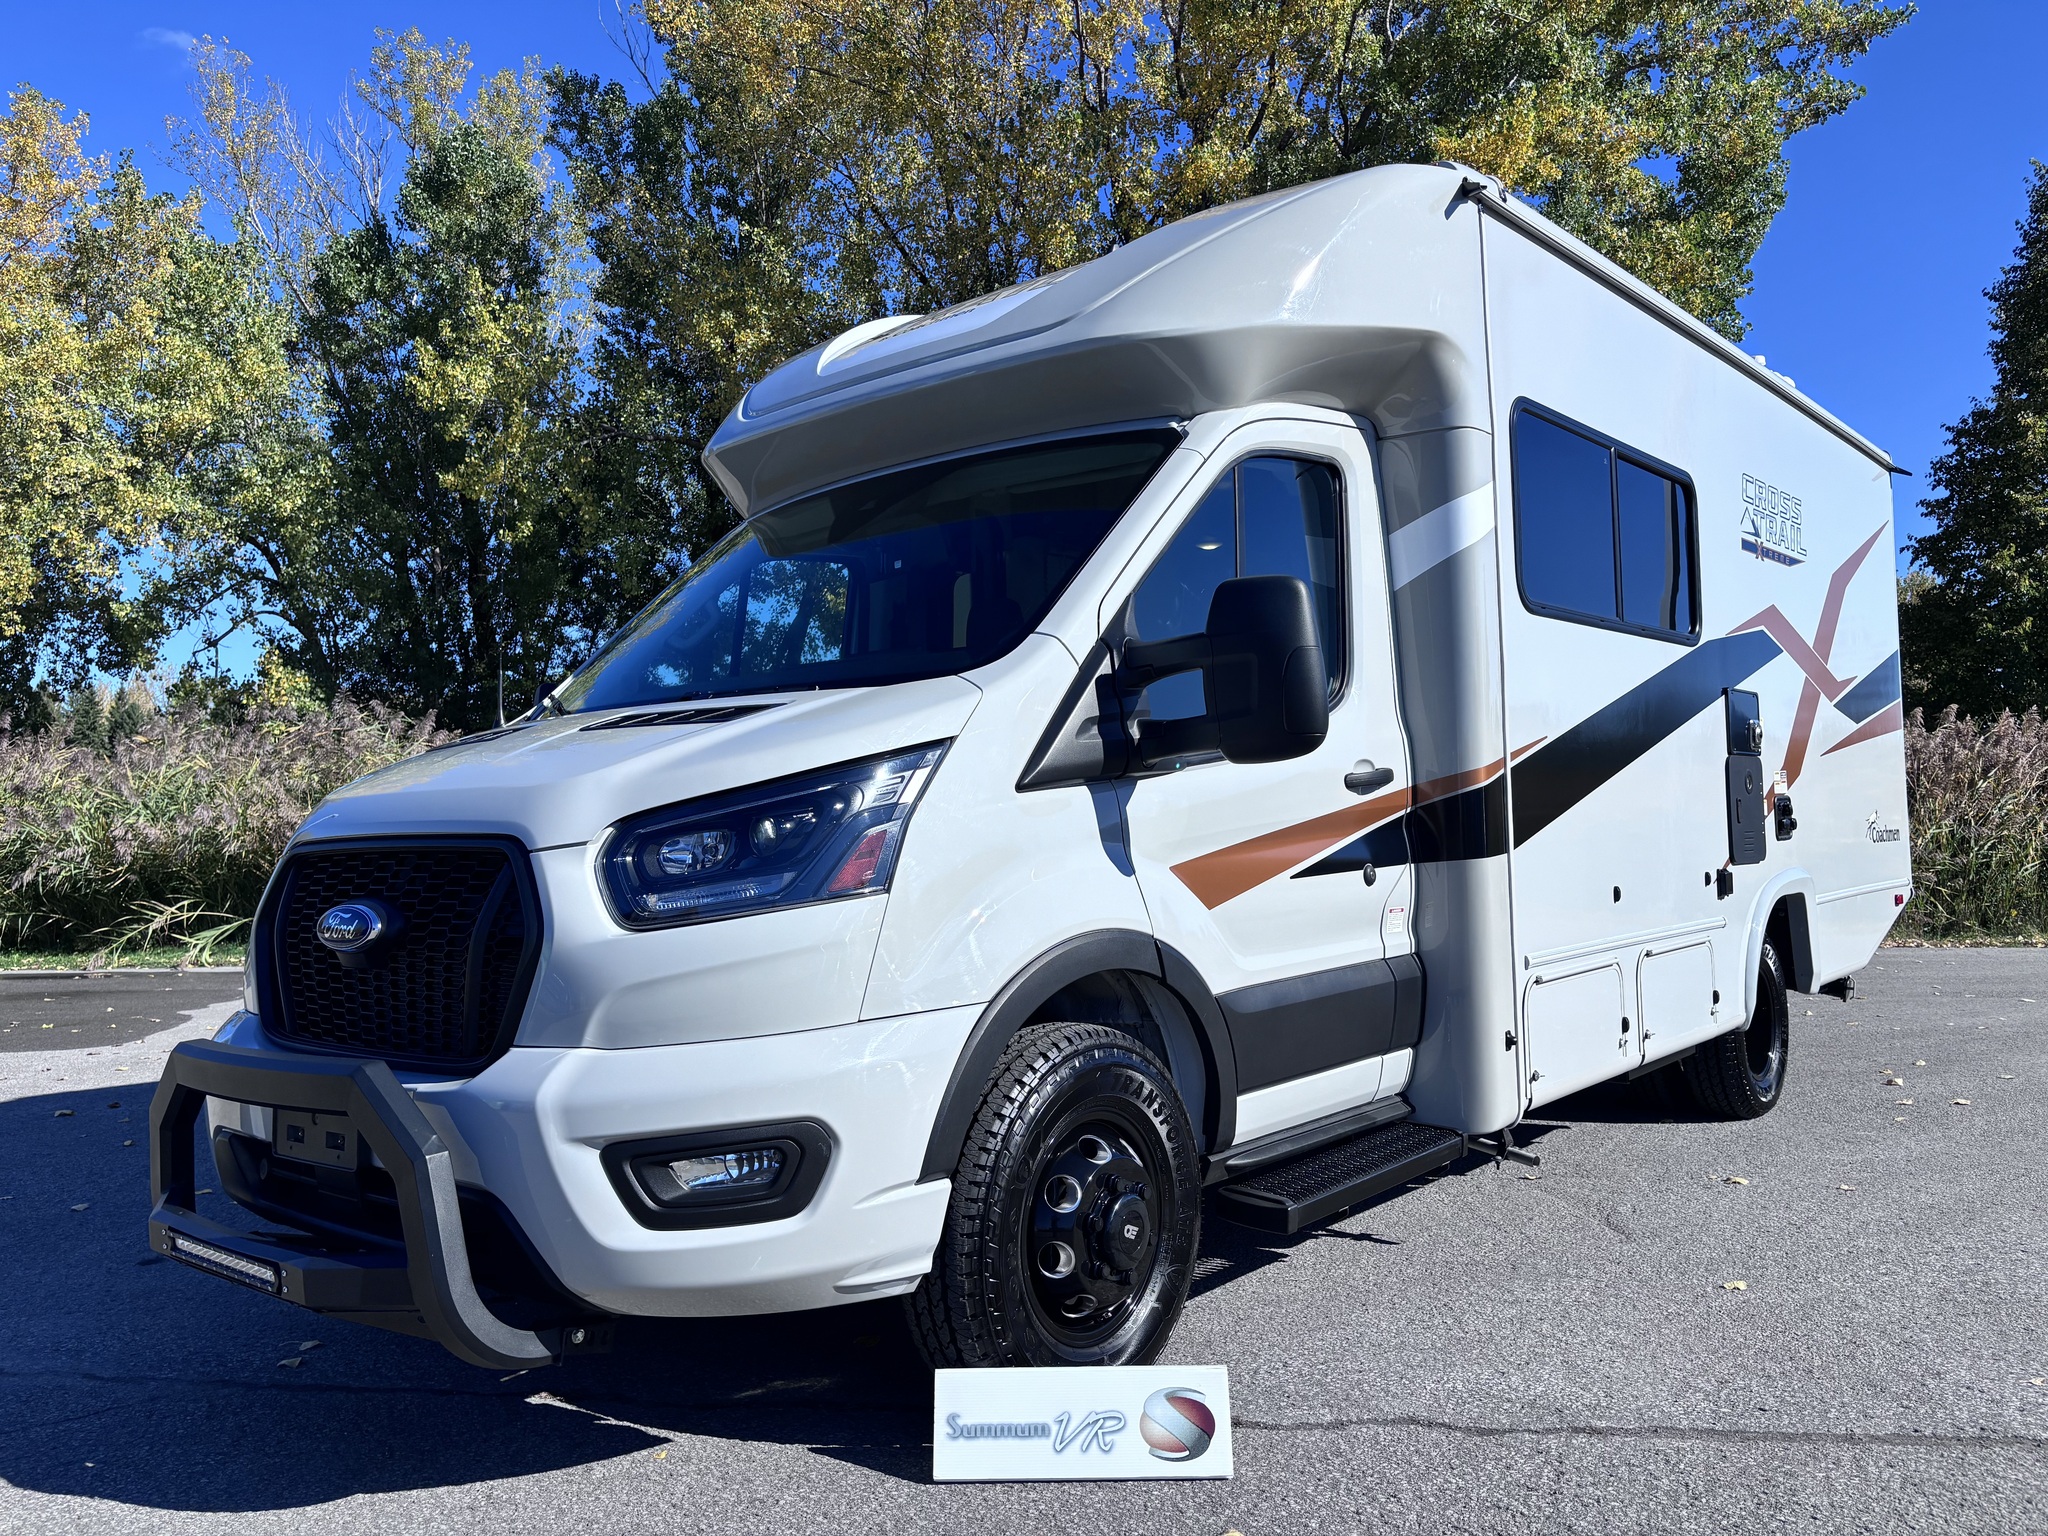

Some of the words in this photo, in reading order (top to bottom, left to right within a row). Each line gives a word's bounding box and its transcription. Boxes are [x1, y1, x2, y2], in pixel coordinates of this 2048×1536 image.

[1741, 472, 1802, 526] CROSS
[1752, 508, 1807, 557] TRAIL
[321, 911, 359, 939] Ford
[1111, 1072, 1191, 1190] TRANSFORCE
[945, 1411, 1051, 1440] Summum
[1052, 1409, 1126, 1452] VR
